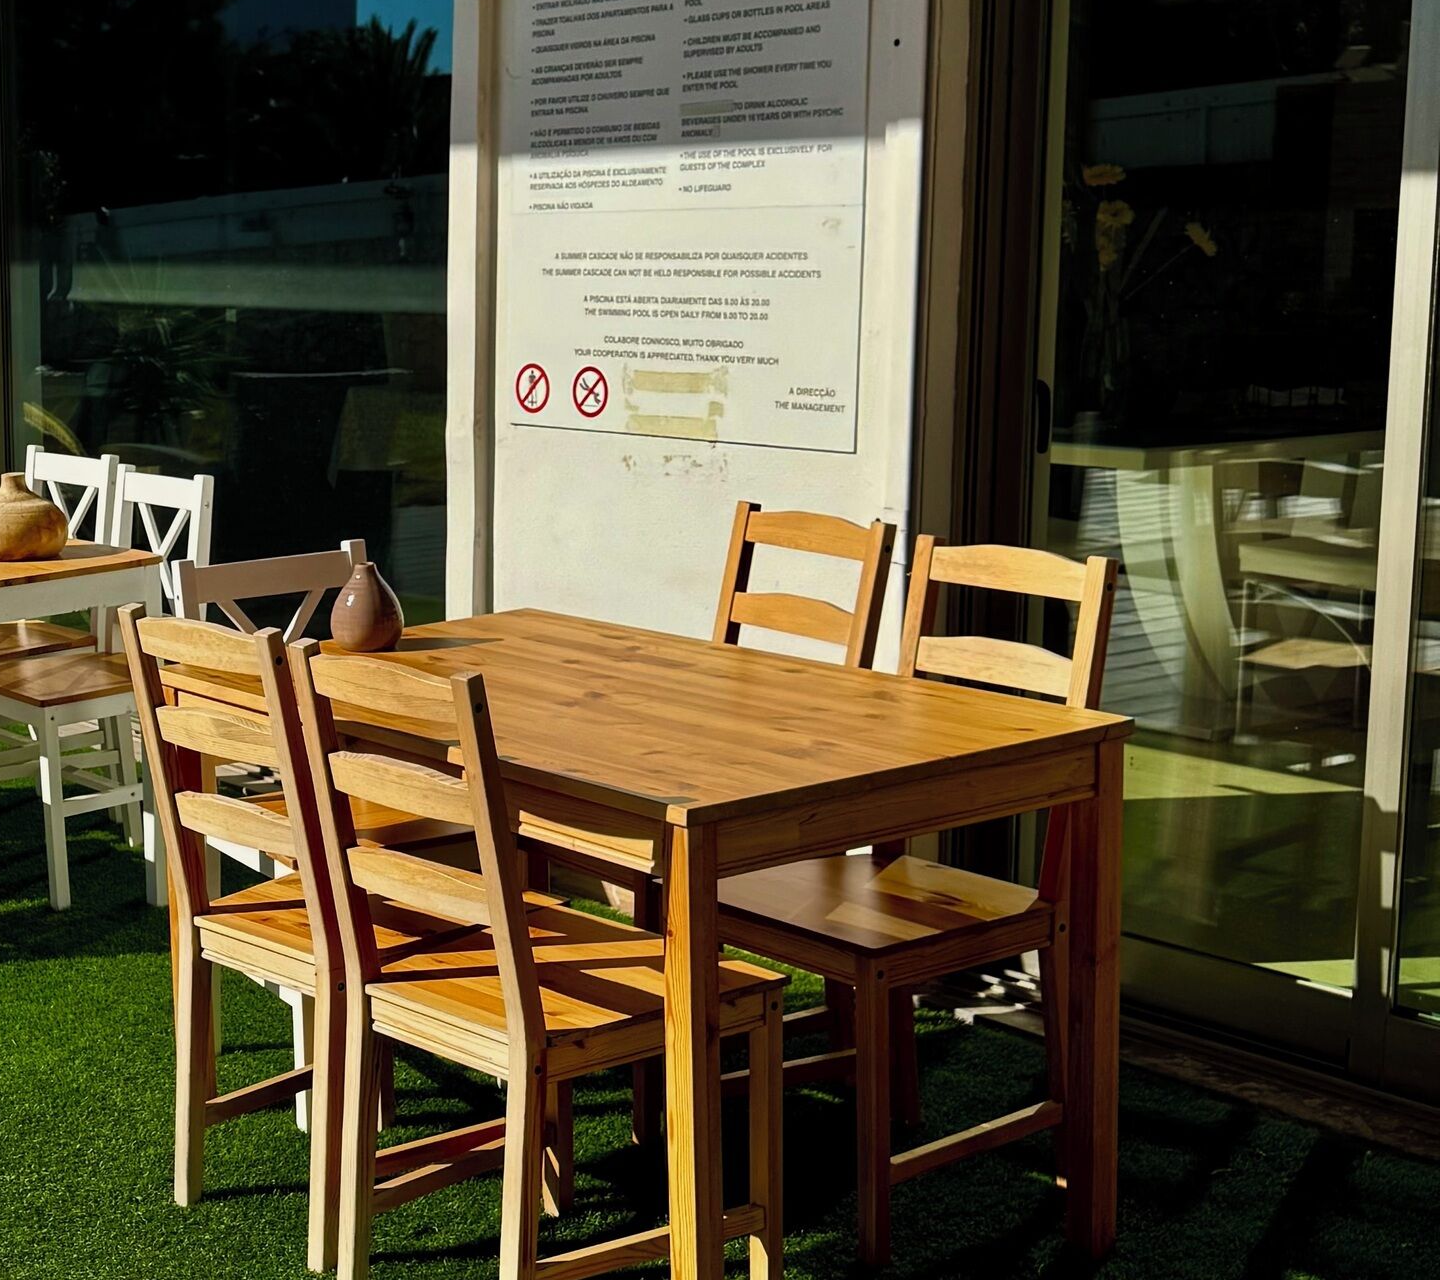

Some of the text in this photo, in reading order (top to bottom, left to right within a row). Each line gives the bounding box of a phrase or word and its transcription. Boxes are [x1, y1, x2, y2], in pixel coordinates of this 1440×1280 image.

[688, 13, 710, 23] GLASS
[711, 11, 730, 20] CUPS
[731, 10, 741, 18] OR
[742, 6, 774, 17] BOTTLES
[784, 3, 803, 13] POOL
[805, 0, 830, 10] AREAS
[687, 25, 820, 45] CHILDREN MUST BE ACCOMPANIED AND
[683, 42, 763, 57] SUPERVISED BY ADULTS
[686, 60, 832, 79] PLEASE USE THE SHOWER EVERY TIME YOU
[682, 80, 738, 92] ENTER THE POOL
[733, 97, 808, 110] TO DRINK ALCOHOLIC
[723, 149, 735, 157] THE
[737, 148, 756, 156] POOL
[758, 147, 765, 155] IS
[766, 145, 813, 154] EXCLUSIVELY
[679, 163, 706, 171] GUESTS
[717, 161, 730, 169] THE
[732, 160, 765, 168] COMPLEX
[619, 251, 633, 259] NÃO
[721, 252, 764, 260] QUAISQUER
[765, 252, 808, 260] ACIDENTES
[582, 268, 612, 276] CASCADE
[628, 268, 641, 276] NOT
[673, 269, 721, 277] RESPONSIBLE
[723, 269, 738, 277] FOR
[778, 270, 821, 278] ACCIDENTS
[589, 295, 614, 303] PISCINA
[633, 296, 658, 304] ABERTA
[660, 297, 706, 305] DIARIAMENTE
[751, 298, 770, 306] 20.00
[598, 308, 631, 316] SWIMMING
[632, 309, 650, 317] POOL
[651, 309, 658, 317] IS
[680, 310, 699, 318] DAILY
[738, 311, 748, 319] TO
[749, 312, 768, 320] 20.00
[603, 335, 639, 344] COLABORE
[682, 338, 704, 346] MUITO
[705, 339, 743, 348] OBRIGADO
[574, 348, 591, 356] YOUR
[592, 349, 638, 358] COOPERATION
[647, 351, 694, 361] APPRECIATED,
[695, 354, 719, 362] THANK
[721, 355, 735, 363] YOU
[757, 357, 779, 365] MUCH
[796, 386, 836, 399] DIRECÇÃO
[775, 400, 845, 412] THE MANAGEMENT
